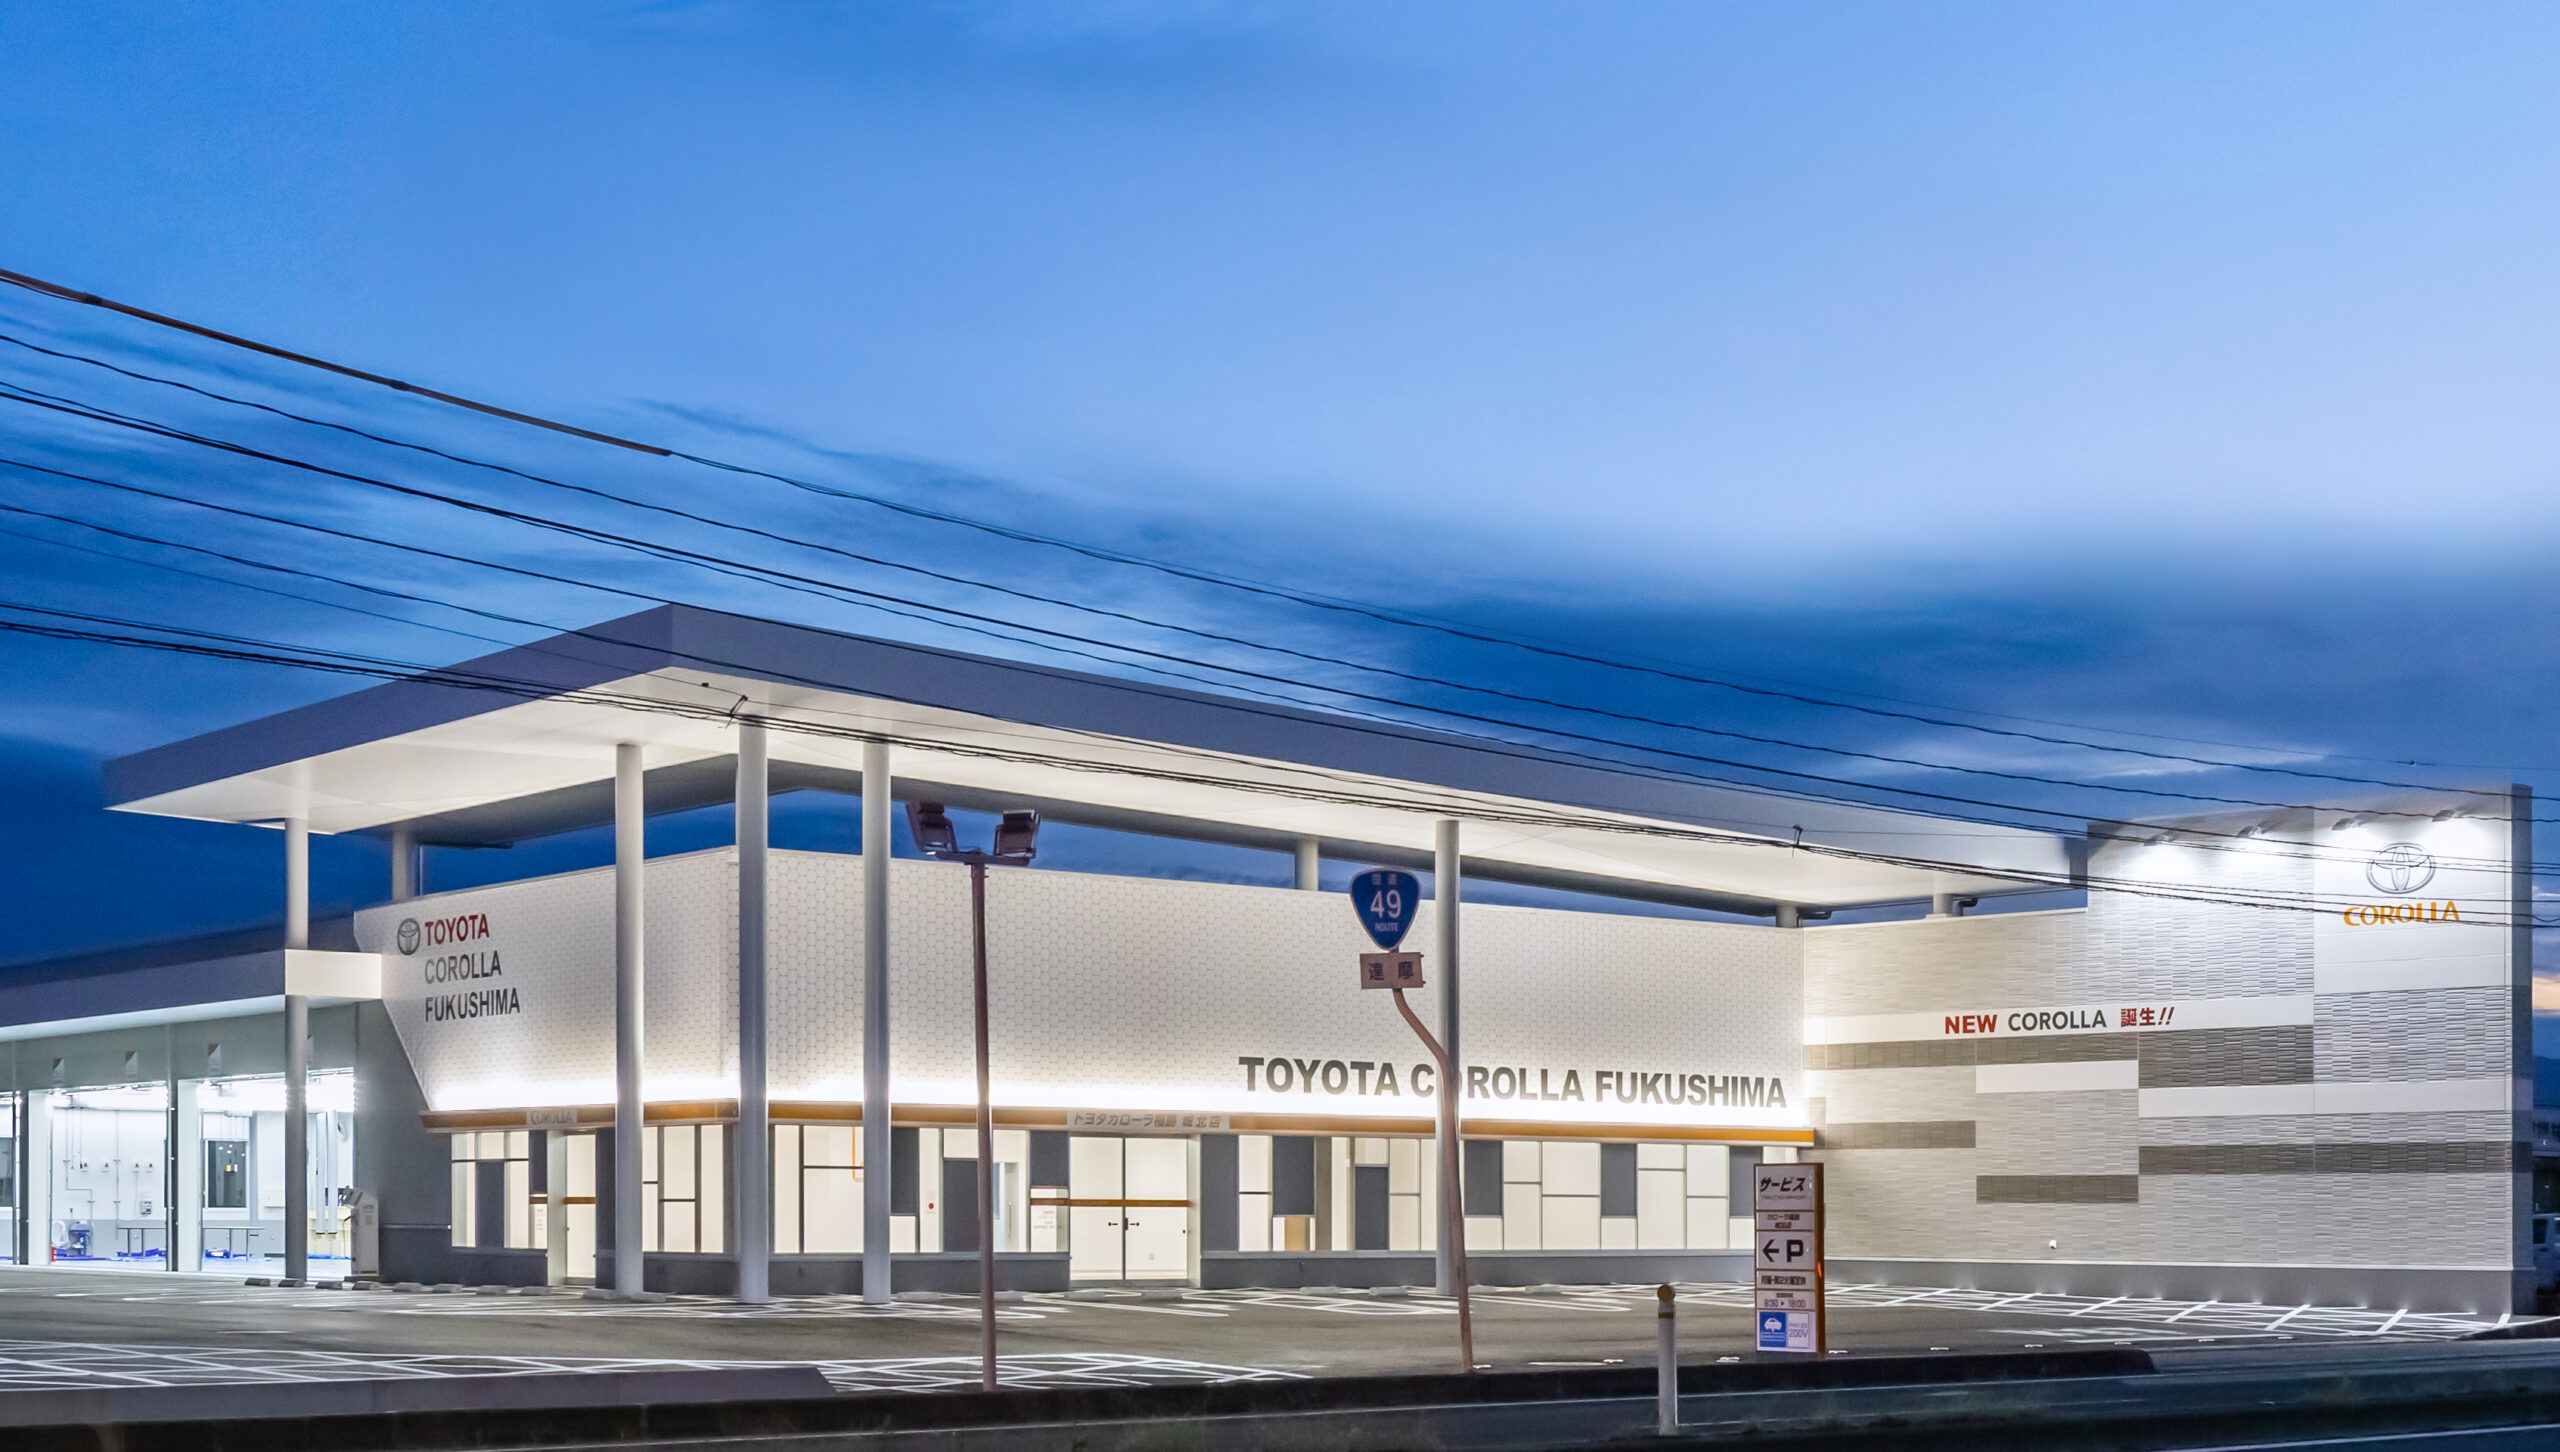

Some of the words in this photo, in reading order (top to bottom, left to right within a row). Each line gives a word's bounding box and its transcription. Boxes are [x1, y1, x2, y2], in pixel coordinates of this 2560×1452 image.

[1370, 889, 1402, 919] 49
[2344, 900, 2460, 926] COROLLA
[425, 913, 490, 946] TOYOTA
[1374, 922, 1400, 932] ROUTE
[425, 950, 502, 984] COROLLA
[425, 987, 520, 1022] FUKUSHIMA
[1945, 1014, 1998, 1034] NEW
[2008, 1009, 2107, 1031] COROLLA
[1238, 1056, 1400, 1097] TOYOTA
[1410, 1063, 1585, 1102] CROLLA
[1595, 1070, 1788, 1109] FUKUSHIMA
[1760, 1176, 1806, 1192] サービス
[1786, 1240, 1804, 1263] P
